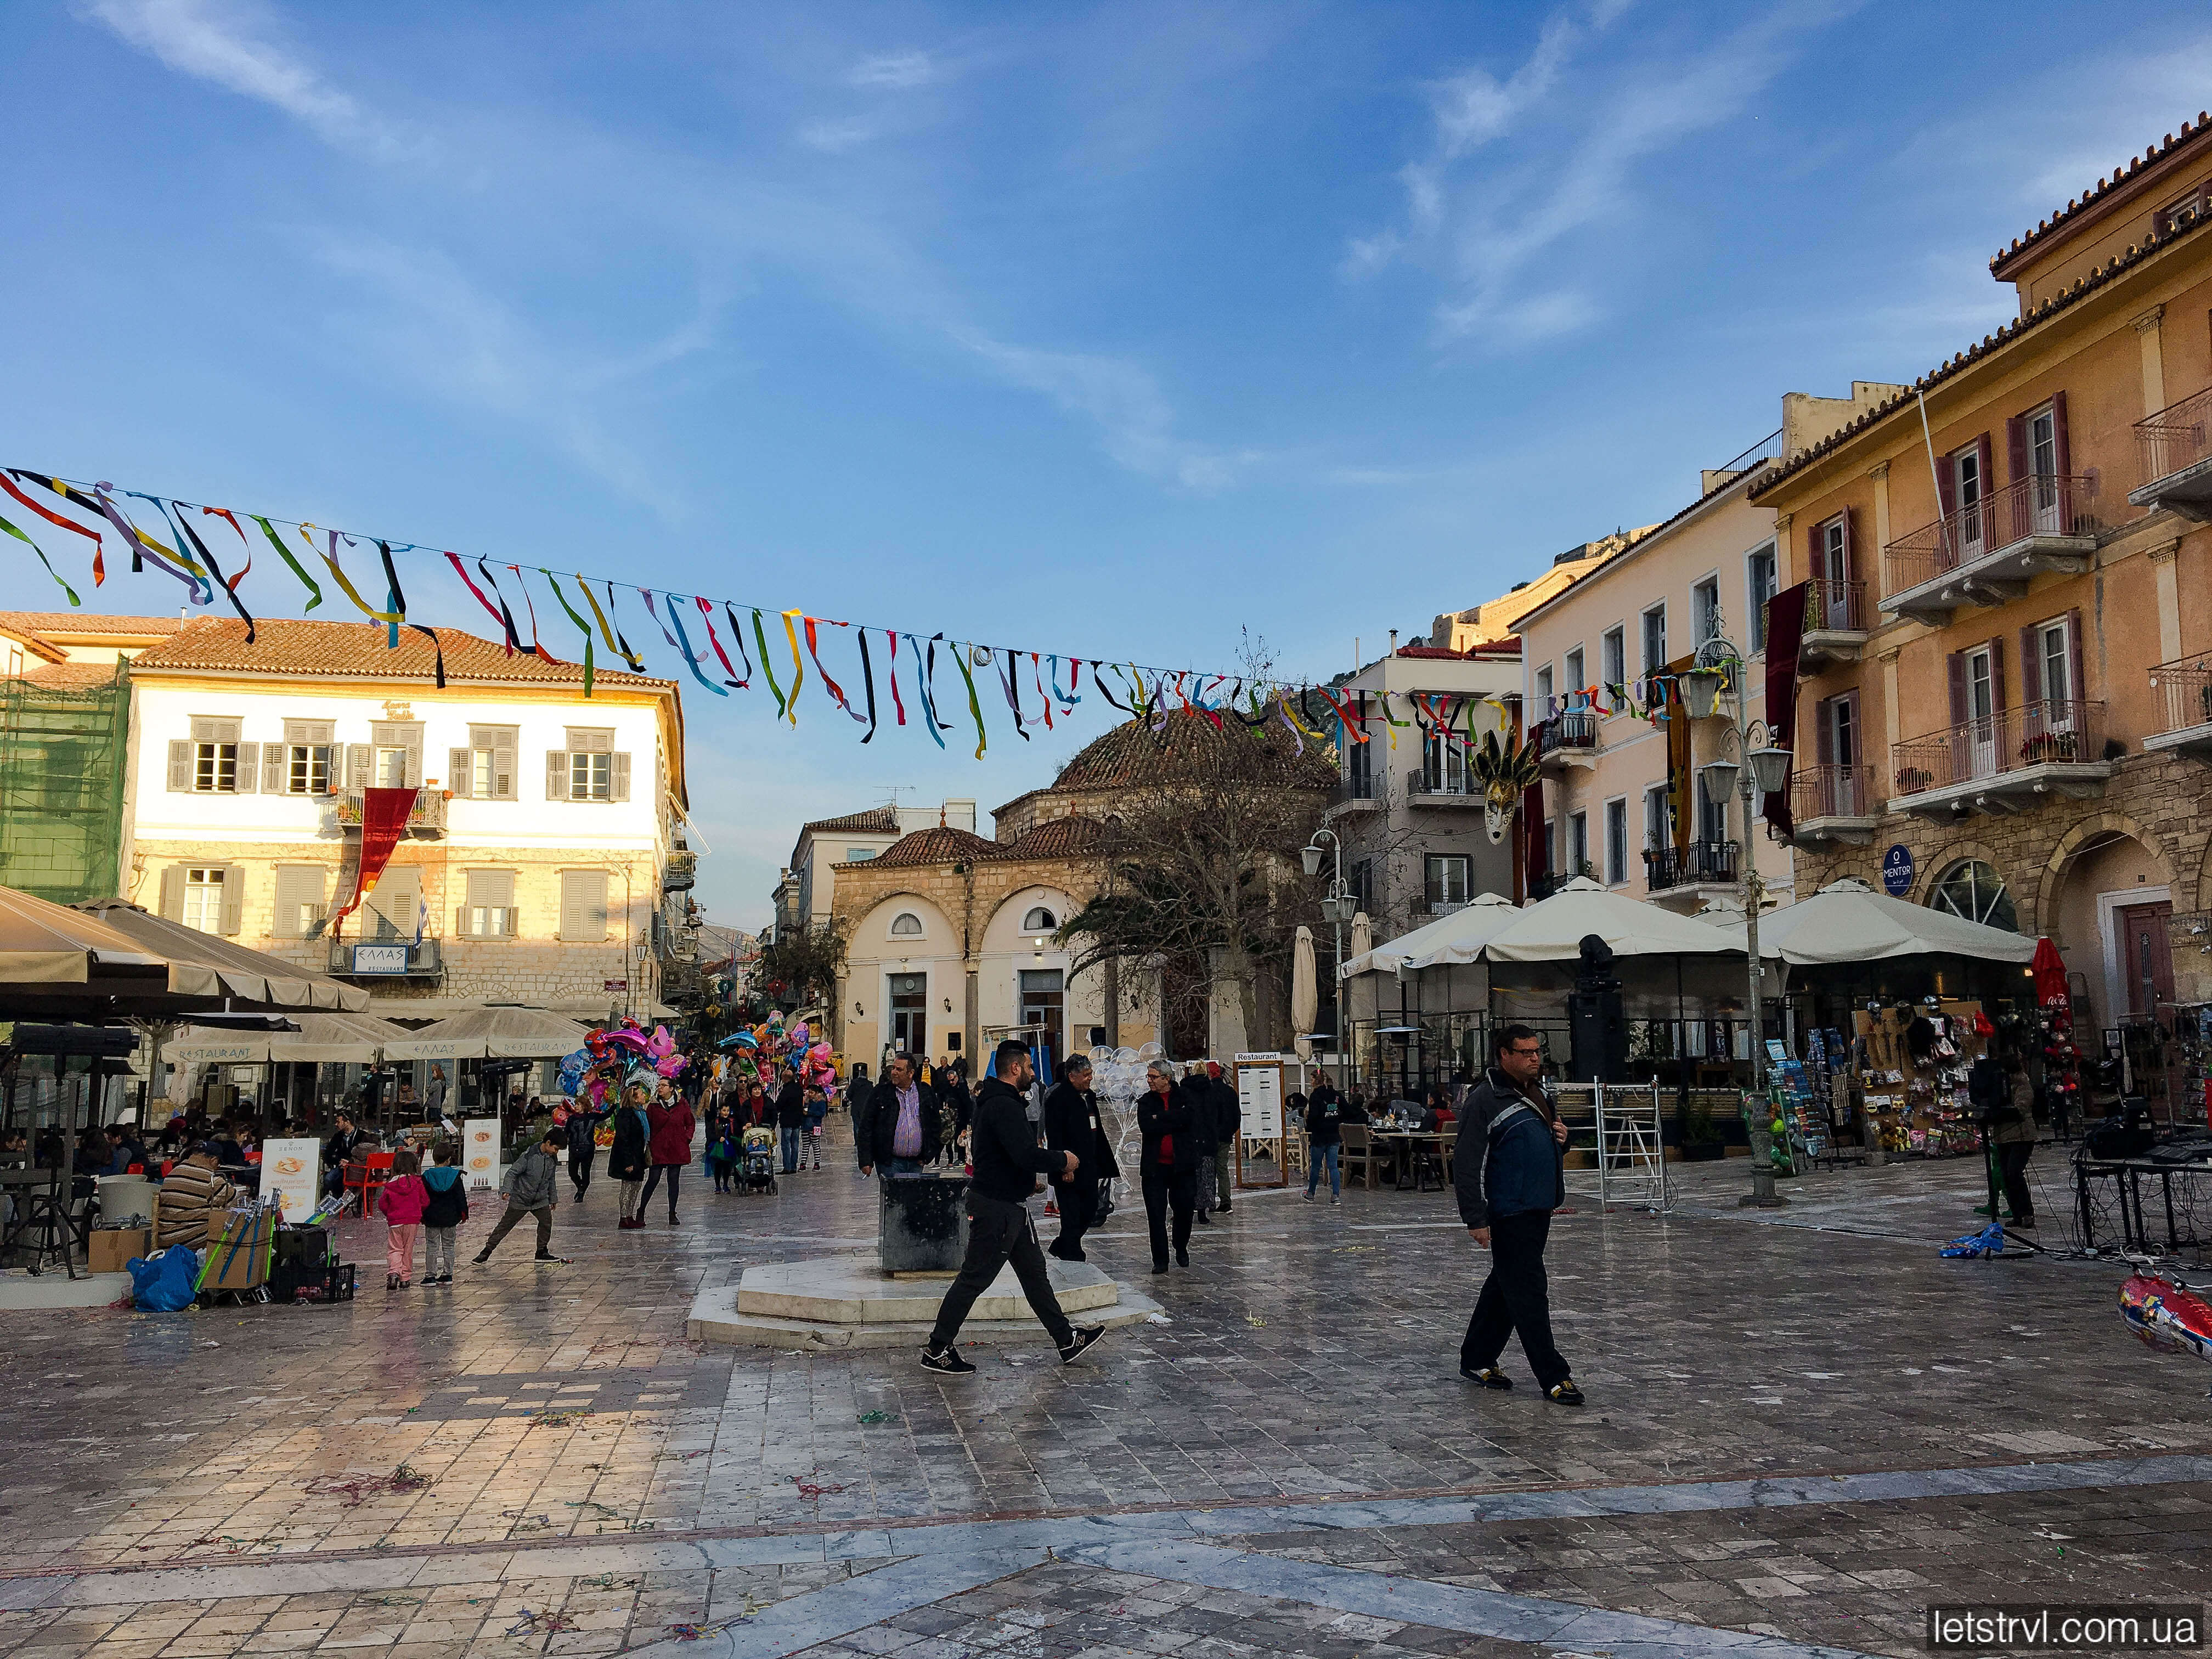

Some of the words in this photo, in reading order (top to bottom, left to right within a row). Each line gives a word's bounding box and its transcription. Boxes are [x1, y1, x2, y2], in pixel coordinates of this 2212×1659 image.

[1883, 865, 1911, 878] MENTOR
[504, 1043, 572, 1052] RESTAURANT
[179, 1048, 251, 1059] RESTAURANT
